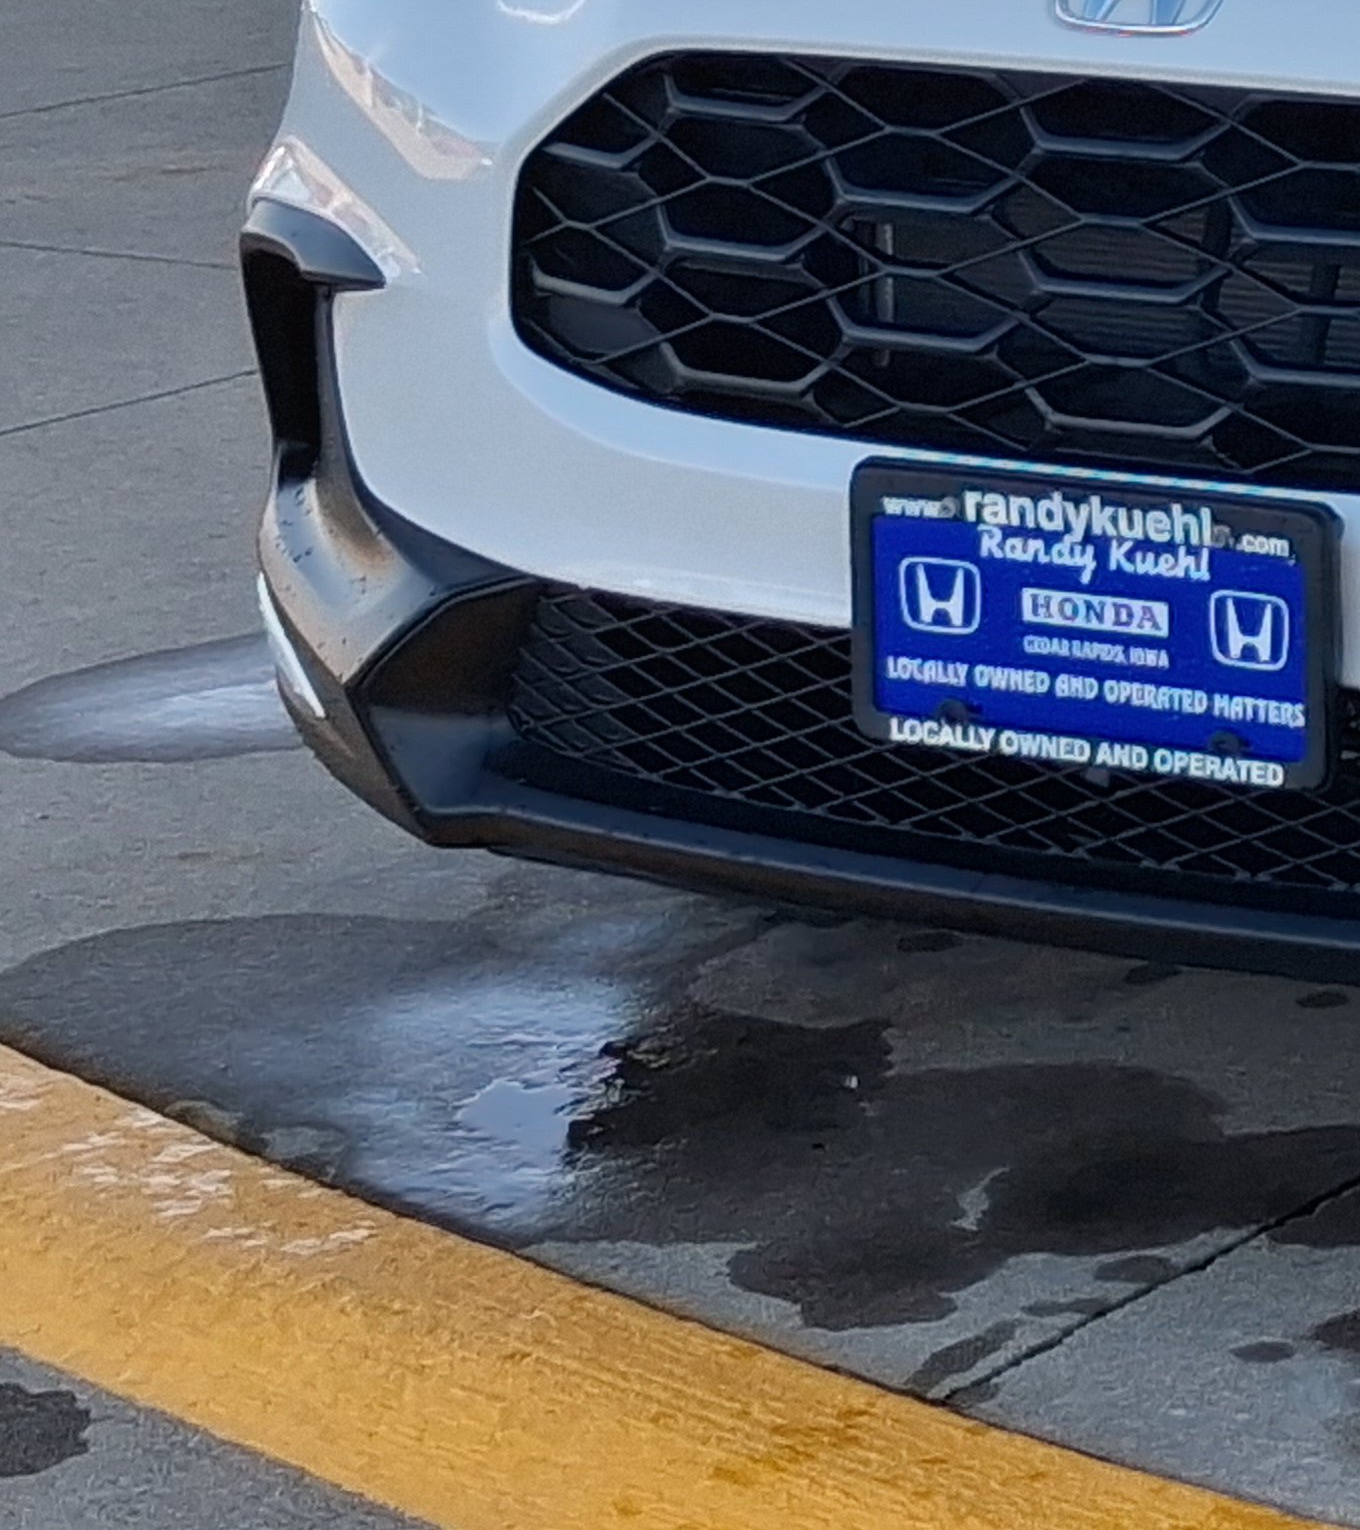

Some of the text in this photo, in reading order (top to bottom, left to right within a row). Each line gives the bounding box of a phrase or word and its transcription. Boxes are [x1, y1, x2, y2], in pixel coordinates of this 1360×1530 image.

[963, 489, 1212, 547] randykuehl
[977, 523, 1211, 585] Randy Kuehl
[1030, 593, 1162, 631] HONDA
[887, 656, 1305, 728] LOCALLY OWNED AND OPERATED MATTERS
[889, 717, 1285, 787] LOCALLY OWNED AND OPERATED
